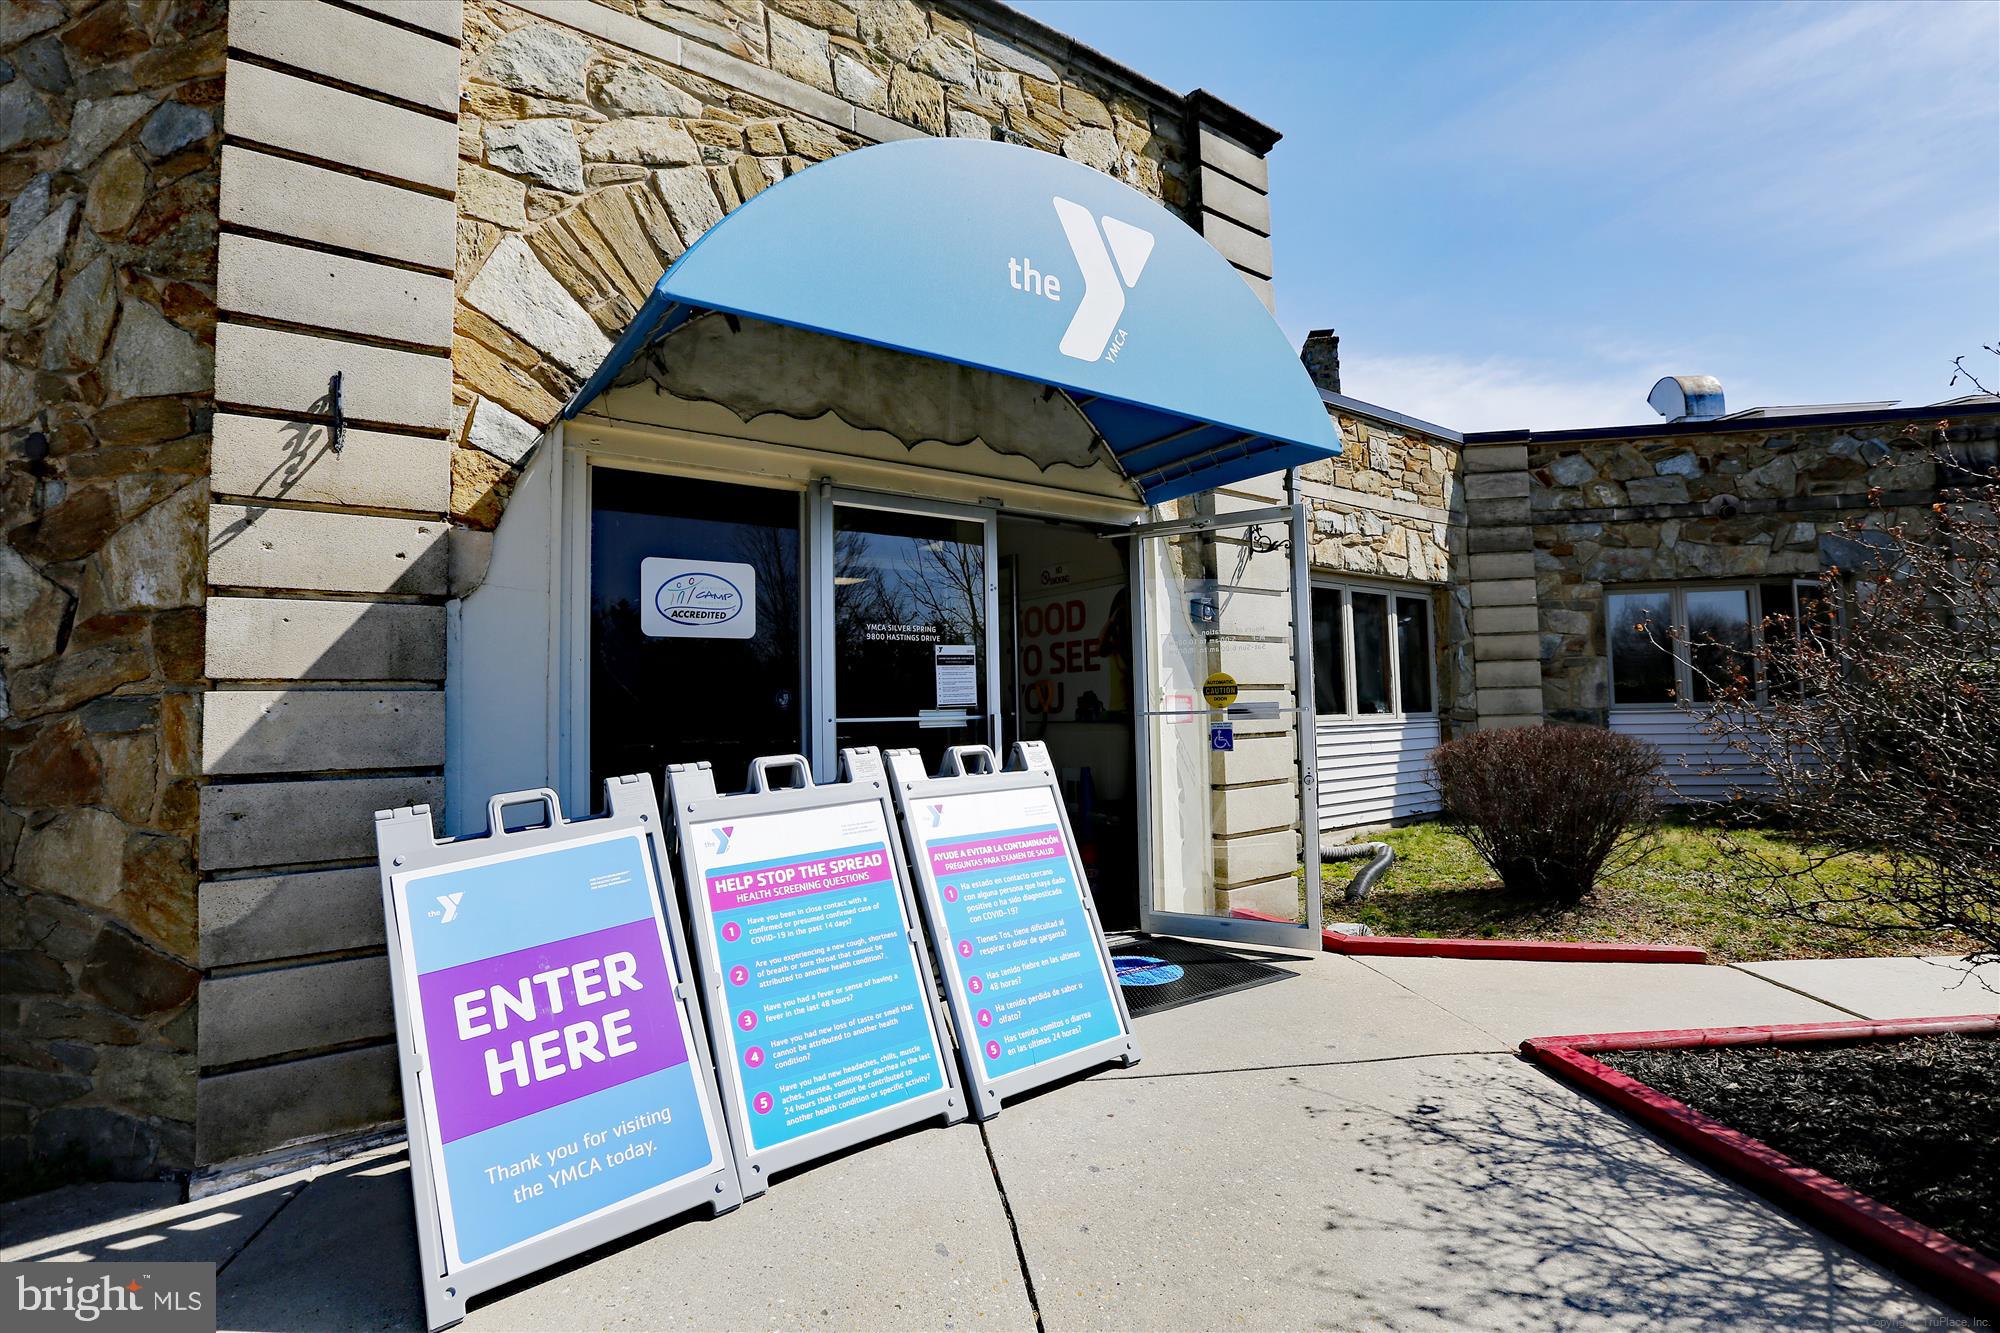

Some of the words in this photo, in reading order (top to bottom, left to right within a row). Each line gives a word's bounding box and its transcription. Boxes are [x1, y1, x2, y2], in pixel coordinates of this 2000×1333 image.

[1008, 256, 1061, 302] the
[1105, 328, 1128, 363] YMCA
[696, 591, 733, 601] CAMP
[671, 610, 727, 620] ACCREDITED
[888, 624, 911, 632] SILVER
[912, 625, 937, 633] SPRING
[1020, 600, 1086, 639] OOD
[886, 634, 920, 642] HASTINGS
[921, 634, 941, 642] DRIVE
[1050, 639, 1101, 674] SEE
[1205, 686, 1236, 694] CAUTION
[934, 850, 960, 861] AYUDE
[960, 850, 967, 858] A
[966, 845, 993, 857] EVITAR
[993, 844, 1004, 853] LA
[1003, 834, 1059, 851] CONTAMINACIÓN
[944, 858, 984, 871] PREGUNTAS
[983, 856, 1001, 865] PARA
[1000, 851, 1027, 862] EXAMEN
[1026, 850, 1036, 858] DE
[1035, 847, 1055, 857] SALUD
[715, 875, 754, 894] HELP
[756, 868, 796, 887] STOP
[797, 863, 828, 879] THE
[829, 853, 883, 874] SPREAD
[736, 889, 772, 903] HEALTH
[773, 879, 822, 897] SCREENING
[822, 871, 870, 889] QUESTIONS
[747, 917, 765, 925] Have
[765, 914, 779, 922] you
[779, 910, 797, 919] been
[805, 905, 823, 914] close
[823, 900, 848, 910] contact
[847, 897, 863, 905] with
[749, 922, 784, 935] confirmed
[793, 913, 825, 928] presumed
[825, 907, 857, 920] confirmed
[857, 905, 872, 913] case
[872, 902, 880, 910] of
[750, 931, 787, 945] COVID-19
[795, 928, 807, 936] the
[807, 925, 823, 934] past
[824, 921, 834, 929] 14
[834, 917, 852, 928] days?
[975, 934, 998, 944] Tienes
[998, 931, 1013, 939] Tos,
[1013, 927, 1030, 936] tiene
[1030, 920, 1058, 933] dificultad
[1058, 918, 1065, 926] al
[979, 944, 1005, 955] respirar
[1012, 939, 1028, 948] dolor
[1029, 936, 1038, 944] de
[1038, 928, 1067, 944] garganta?
[755, 960, 768, 968] Are
[769, 957, 782, 966] you
[783, 947, 826, 962] experiencing
[831, 943, 845, 951] new
[846, 937, 868, 948] cough,
[867, 931, 898, 943] shortness
[757, 970, 765, 978] of
[765, 965, 789, 976] breath
[799, 960, 815, 969] sore
[815, 954, 837, 965] throat
[837, 951, 852, 960] that
[852, 946, 874, 956] cannot
[986, 971, 1000, 980] Has
[1000, 965, 1021, 977] tenido
[1021, 961, 1041, 971] fiebre
[1049, 956, 1060, 964] las
[1059, 951, 1081, 961] ultimas
[759, 974, 794, 988] attributed
[804, 966, 830, 978] another
[831, 961, 852, 971] health
[852, 952, 884, 966] condition?
[989, 982, 1000, 991] 48
[999, 976, 1022, 988] horas?
[453, 951, 644, 1041] ENTER
[770, 1038, 789, 1048] Have
[789, 1035, 804, 1044] you
[804, 1029, 818, 1039] had
[818, 1026, 833, 1035] new
[833, 1022, 848, 1031] loss
[848, 1018, 857, 1027] of
[857, 1015, 874, 1025] taste
[883, 1006, 900, 1017] smell
[900, 1003, 914, 1012] that
[773, 1046, 797, 1059] cannot
[798, 1044, 807, 1052] be
[809, 1033, 843, 1049] attributed
[852, 1024, 878, 1036] another
[878, 1018, 899, 1029] health
[1003, 1034, 1018, 1044] Has
[1018, 1027, 1040, 1039] tenido
[1039, 1020, 1065, 1033] vomitos
[1070, 1011, 1092, 1023] diarrea
[1007, 1048, 1017, 1056] en
[1016, 1044, 1029, 1053] las
[1028, 1036, 1052, 1049] ultimas
[1052, 1032, 1061, 1041] 24
[1061, 1025, 1082, 1038] horas?
[484, 1008, 638, 1096] HERE
[774, 1052, 811, 1070] condition?
[484, 1153, 543, 1185] Thank
[546, 1142, 579, 1167] you
[583, 1130, 608, 1149] for
[613, 1107, 672, 1138] visiting
[513, 1183, 544, 1204] the
[548, 1157, 602, 1189] YMCA
[606, 1140, 657, 1168] today.
